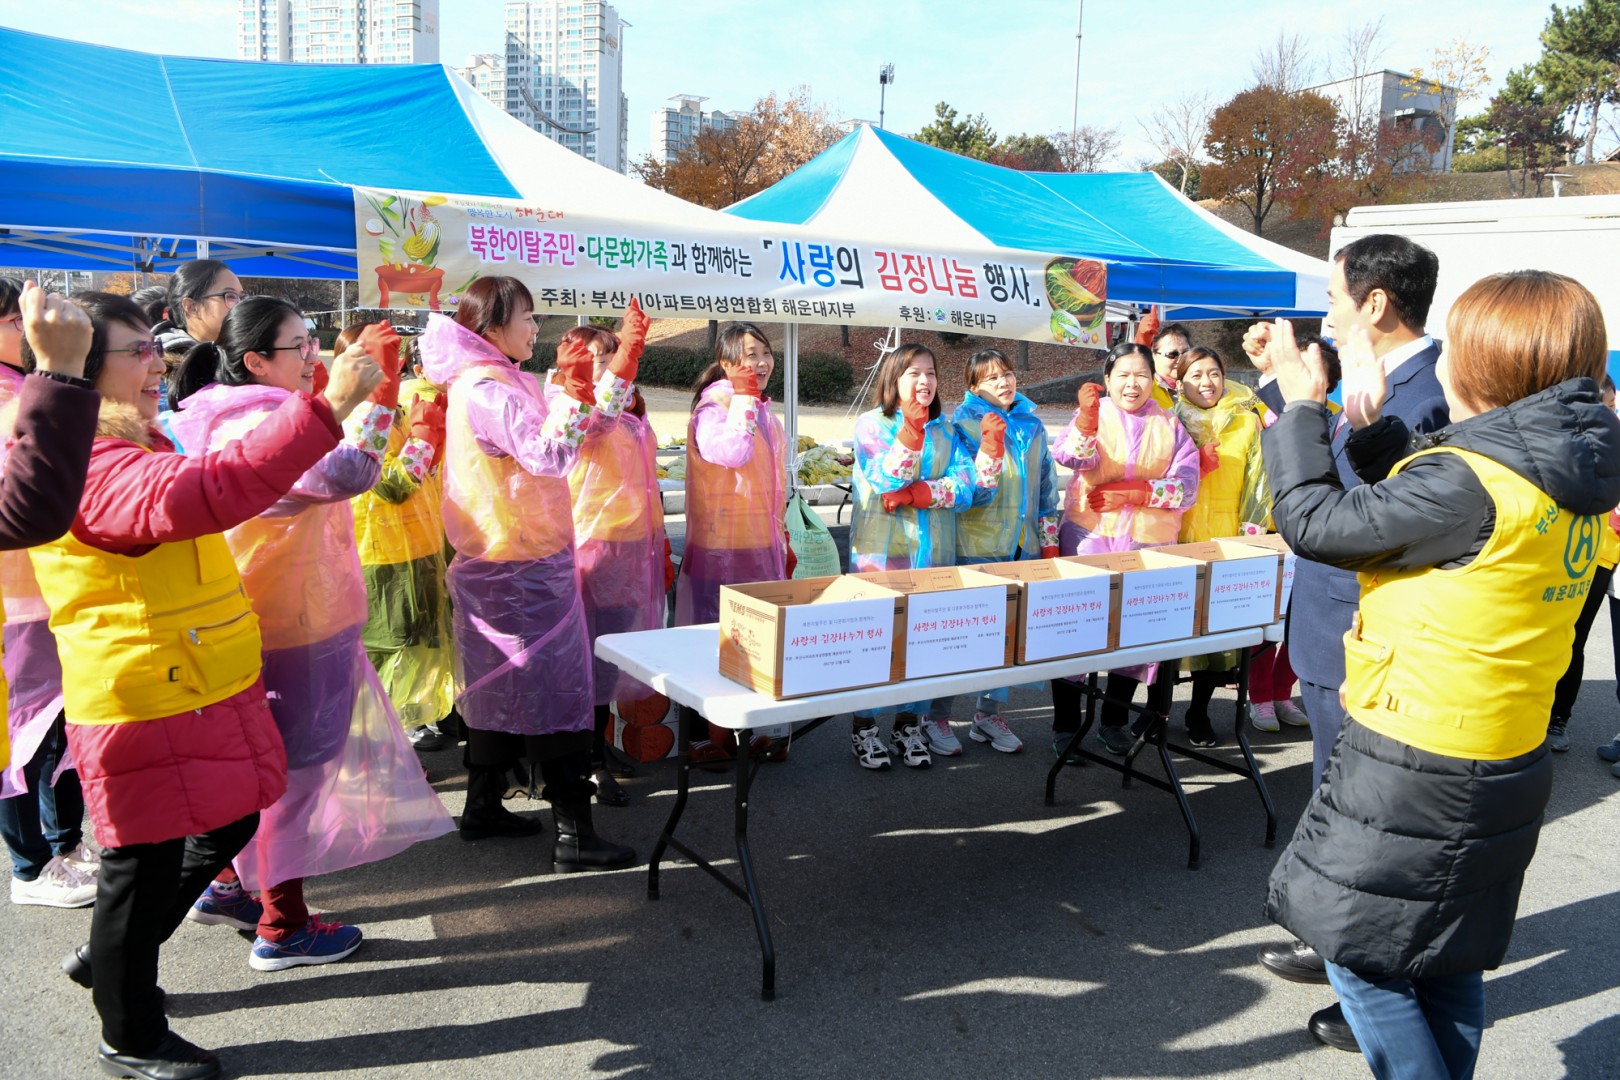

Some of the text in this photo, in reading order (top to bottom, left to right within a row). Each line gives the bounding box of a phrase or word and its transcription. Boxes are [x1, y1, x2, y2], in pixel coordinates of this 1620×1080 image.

[515, 207, 564, 223] 해운대
[691, 243, 753, 278] 함께하는
[875, 251, 979, 299] 김장나눔
[782, 298, 857, 319] 해운대지부
[951, 310, 998, 331] 해운대구
[913, 614, 997, 632] 사랑의 김장나누기 행사
[791, 627, 883, 647] 사랑의 김장나누기 행사
